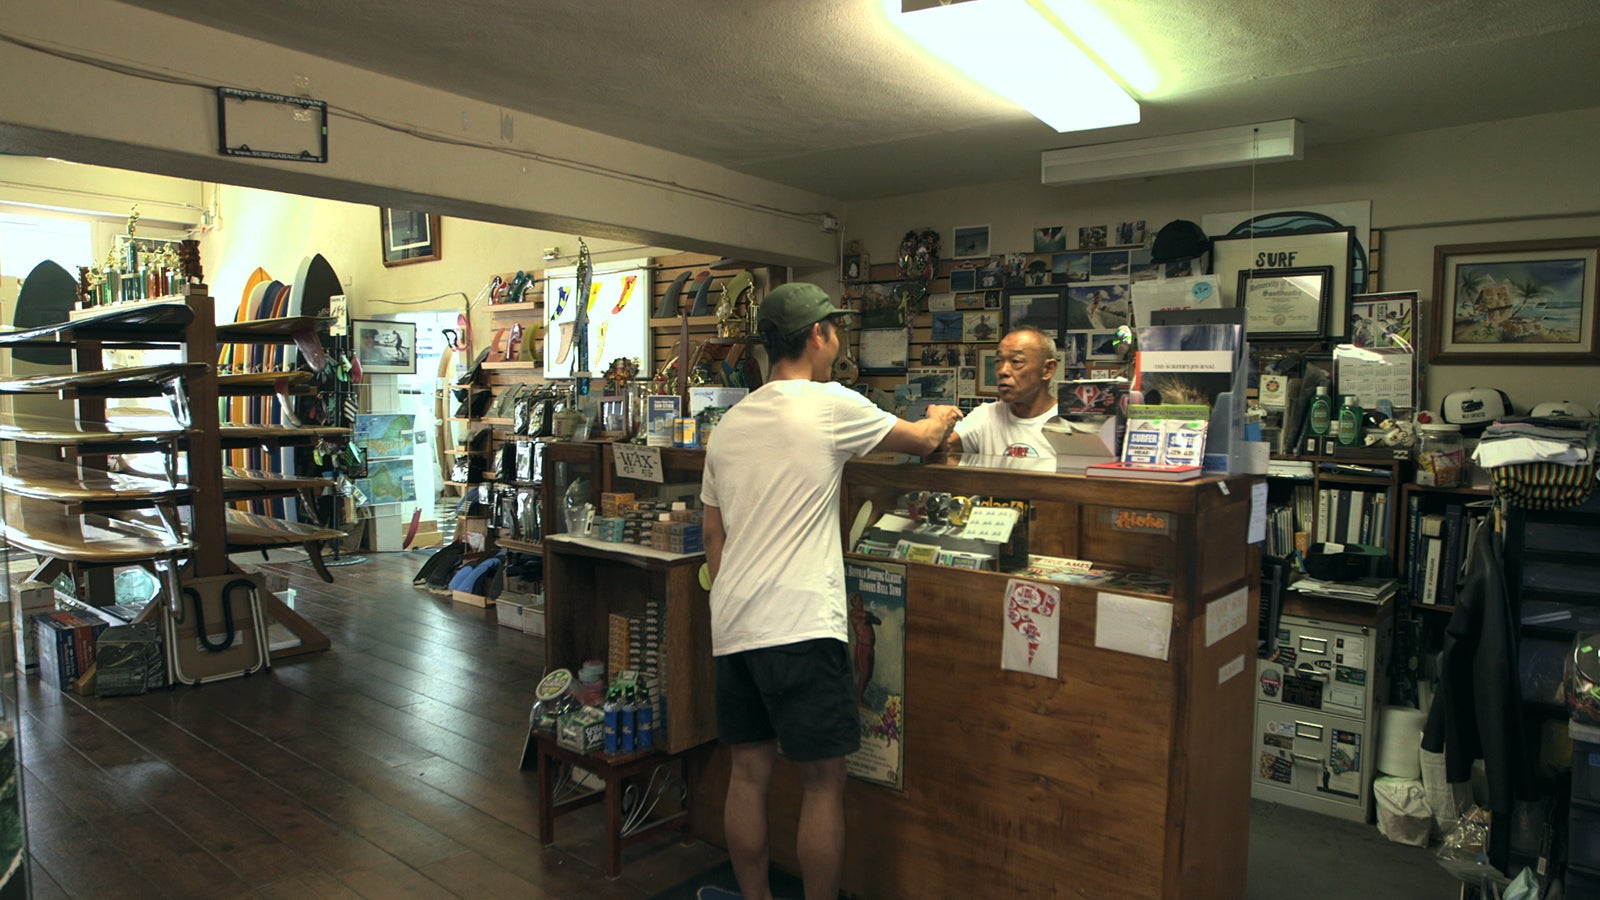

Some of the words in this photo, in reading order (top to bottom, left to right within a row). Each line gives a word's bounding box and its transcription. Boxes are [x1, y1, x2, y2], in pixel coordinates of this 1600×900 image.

[225, 88, 257, 97] PRAY
[260, 93, 283, 101] FOR
[286, 97, 322, 106] JAPAN
[1256, 251, 1298, 267] SURF
[1115, 511, 1166, 529] Aloha
[1042, 558, 1062, 567] TRUE
[1065, 561, 1090, 569] AMES
